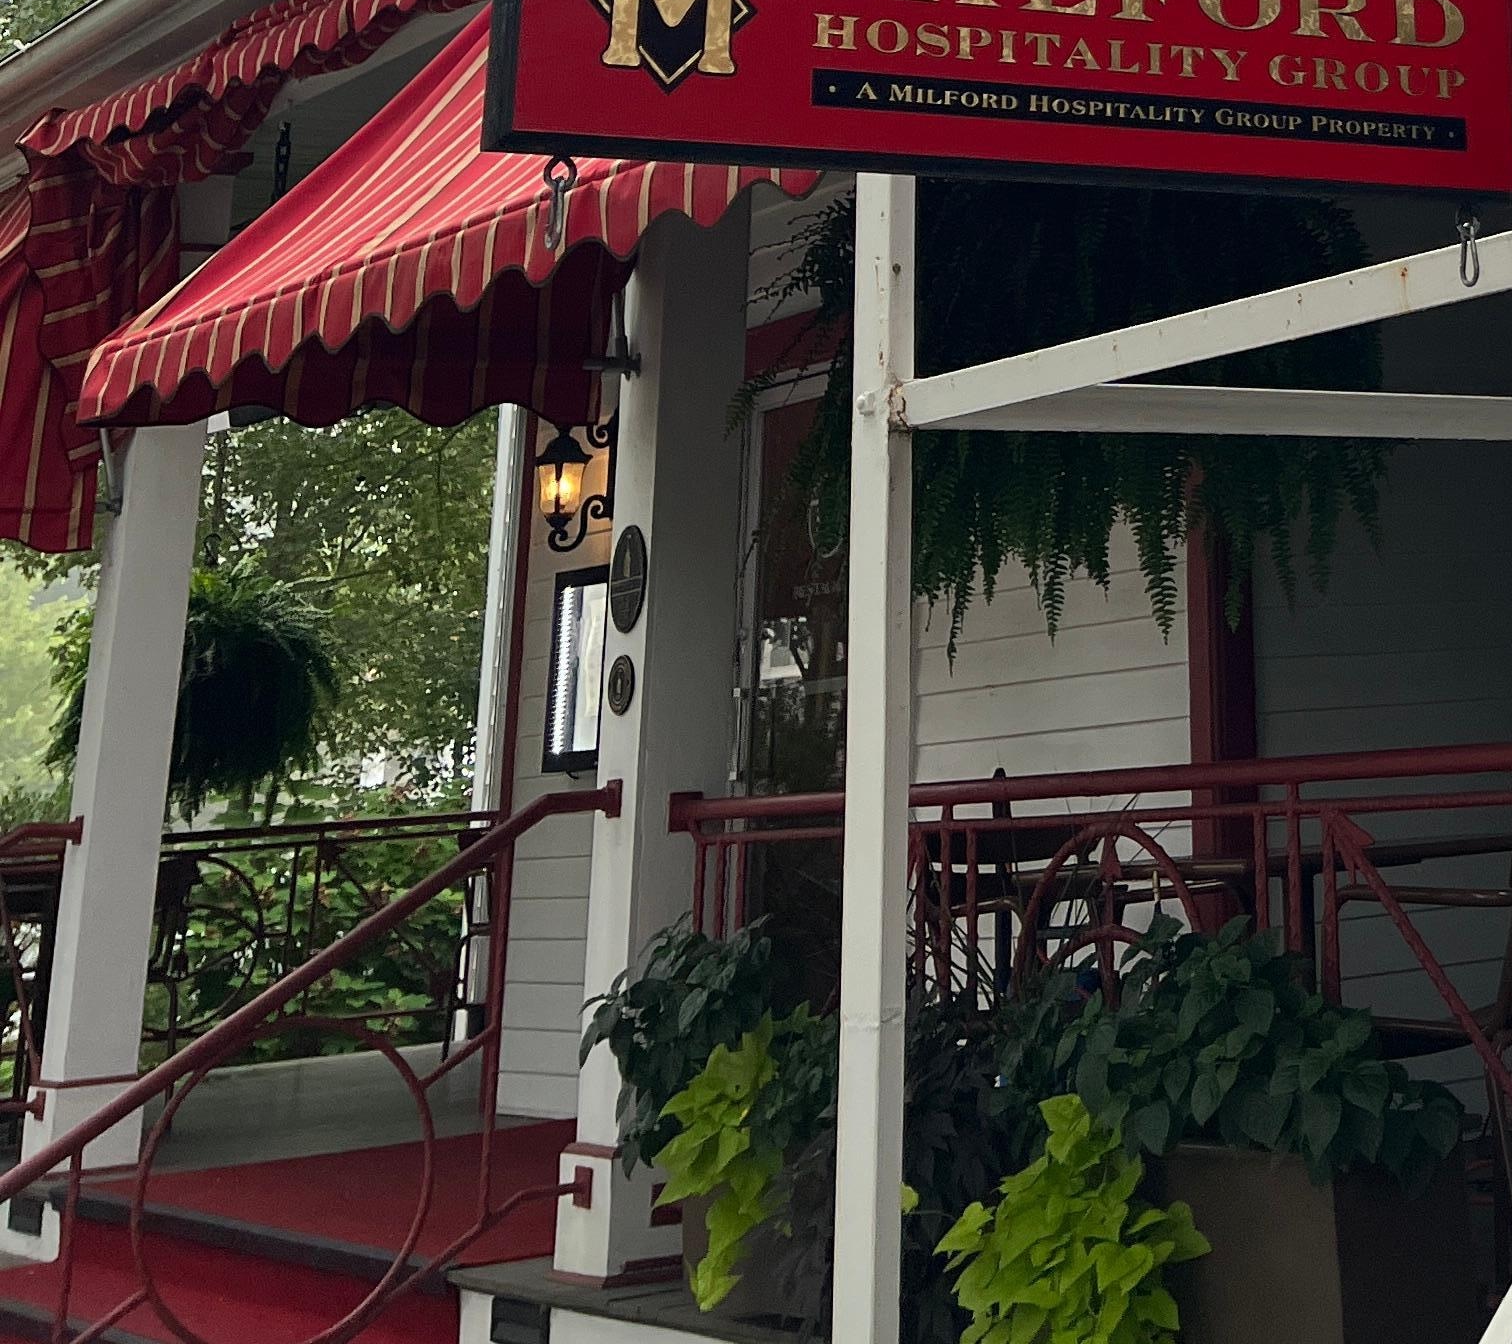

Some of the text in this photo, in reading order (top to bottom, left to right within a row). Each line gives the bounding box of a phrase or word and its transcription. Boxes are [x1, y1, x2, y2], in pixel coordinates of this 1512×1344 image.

[812, 13, 1467, 101] HOSPITALITY GROUP
[855, 81, 1437, 142] A MILFORD HOSPITALITY GROUP PROPERTY
